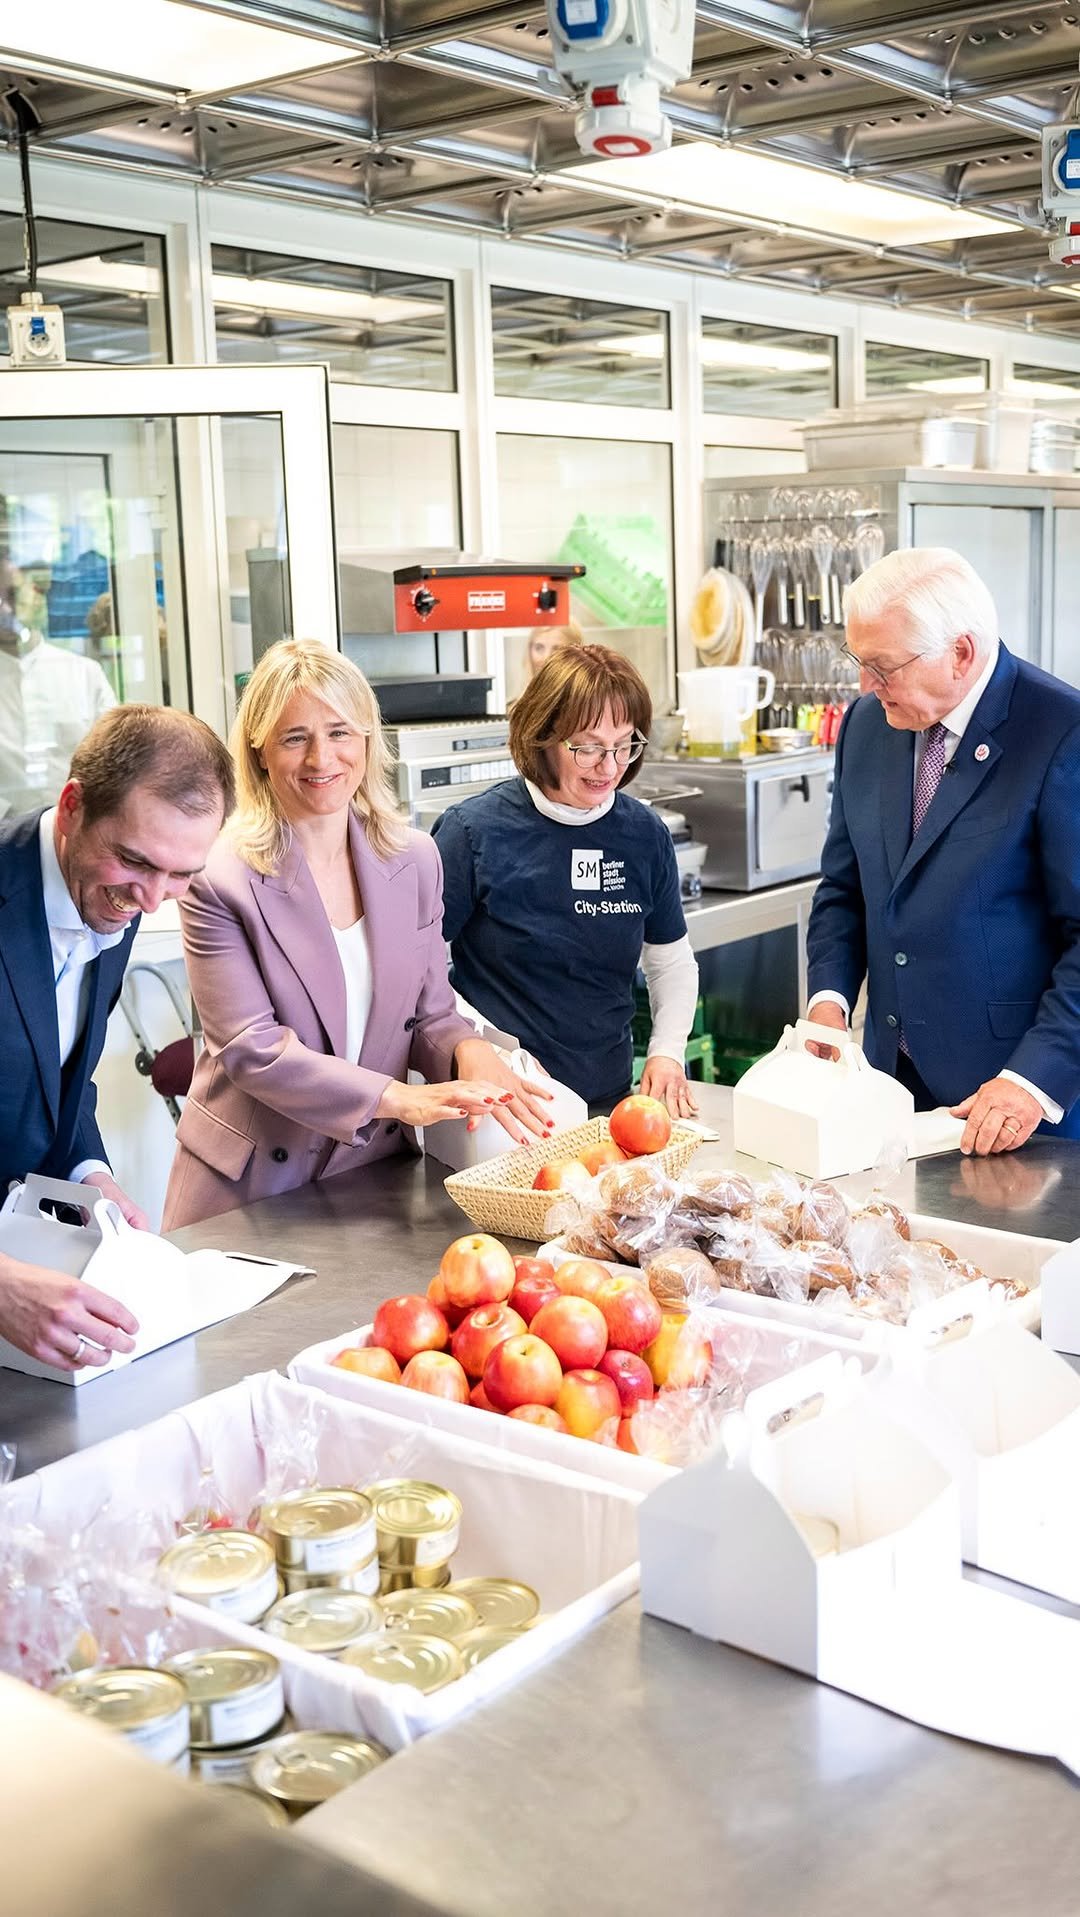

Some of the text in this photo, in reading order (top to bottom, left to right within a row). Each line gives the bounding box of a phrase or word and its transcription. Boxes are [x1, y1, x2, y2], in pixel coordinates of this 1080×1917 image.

[577, 861, 597, 878] SM
[602, 860, 625, 870] berliner
[603, 869, 619, 878] stadt
[603, 877, 626, 886] mission
[574, 900, 642, 916] City-Station
